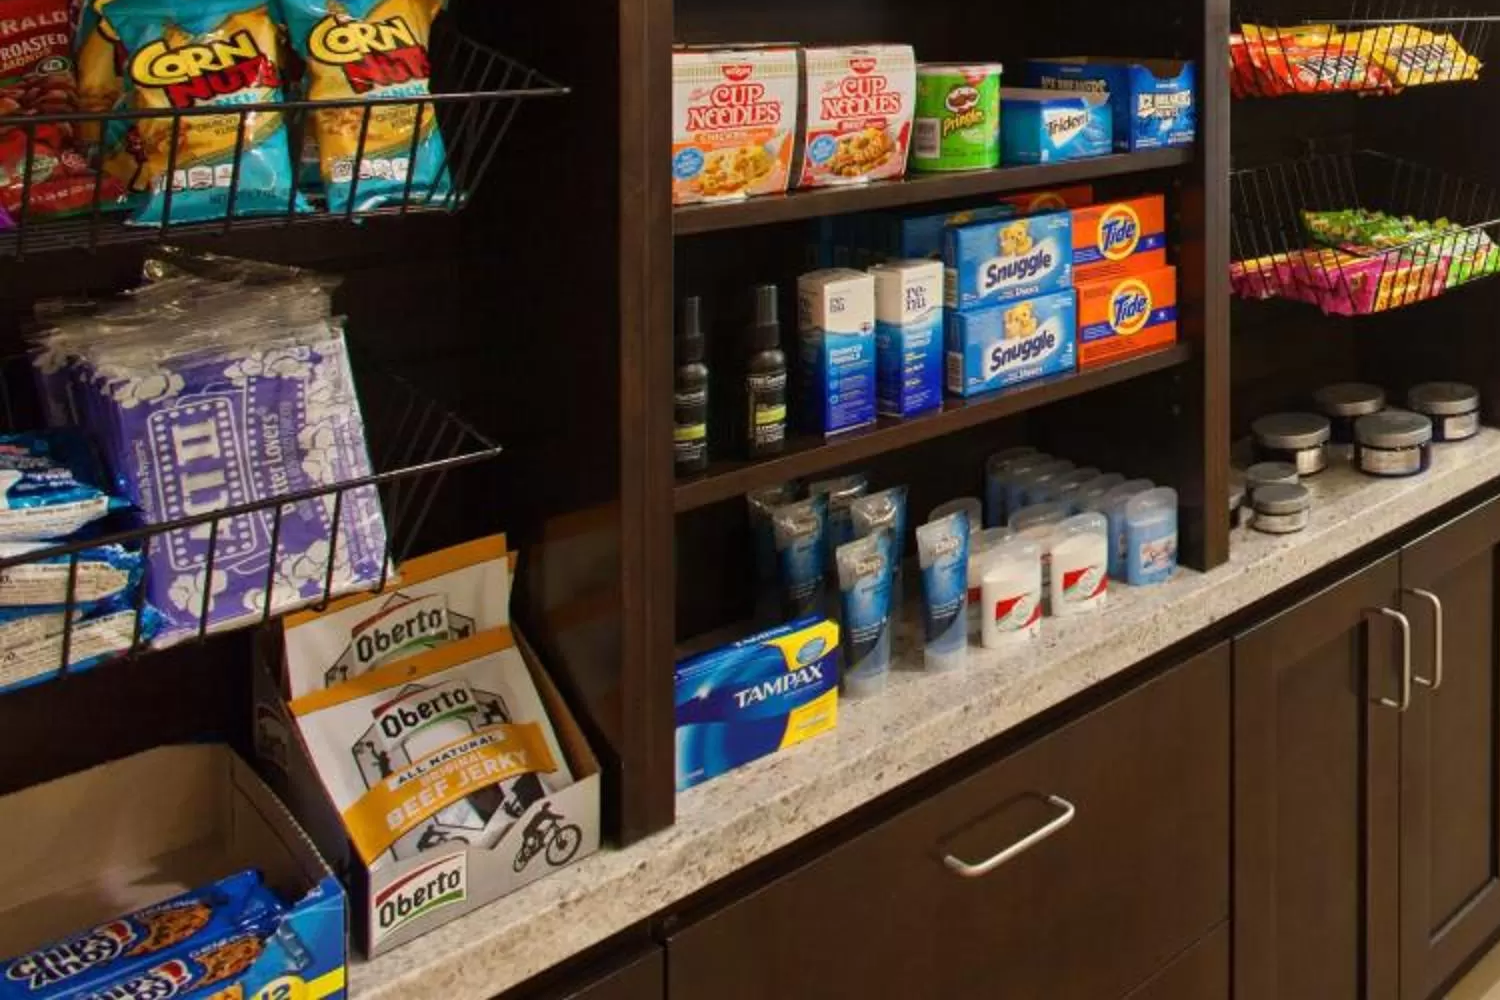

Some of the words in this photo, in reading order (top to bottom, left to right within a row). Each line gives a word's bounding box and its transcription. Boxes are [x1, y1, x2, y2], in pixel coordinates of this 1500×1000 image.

[1, 10, 68, 35] RALD
[308, 16, 417, 65] CORN
[1, 32, 69, 61] ROASTED
[131, 30, 258, 86] CORN
[711, 84, 764, 107] CUP
[840, 76, 887, 97] CUP
[686, 102, 781, 132] NOODLES
[821, 93, 901, 120] NOODLES
[1101, 219, 1136, 252] Tide
[985, 251, 1052, 289] Snuggle
[1113, 294, 1149, 328] Tide
[990, 332, 1055, 371] Snuggle
[356, 608, 442, 663] Oberto
[734, 662, 824, 709] TAMPAX
[380, 687, 469, 738] Oberto
[397, 765, 427, 785] ALL
[429, 734, 499, 767] NATURAL
[386, 778, 449, 831] BEEF
[457, 750, 527, 789] JERKY
[379, 867, 462, 930] Oberto
